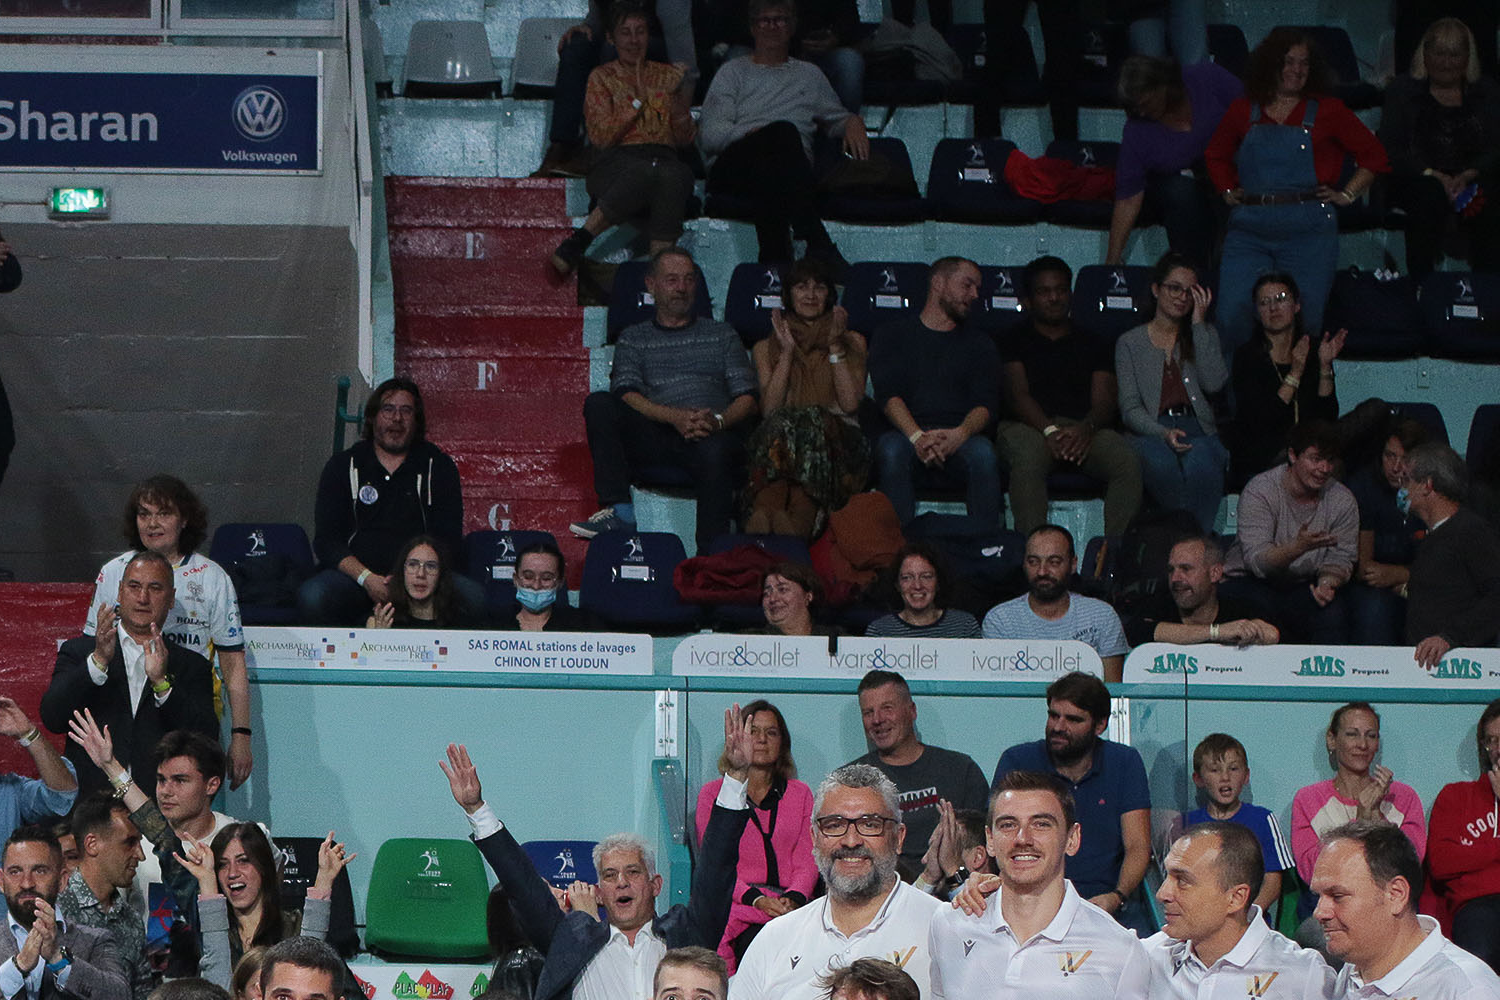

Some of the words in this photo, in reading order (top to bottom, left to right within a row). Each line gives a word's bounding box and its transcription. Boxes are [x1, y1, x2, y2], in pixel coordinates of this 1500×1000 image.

[221, 149, 298, 164] Volkswagen
[465, 232, 485, 260] E
[476, 361, 498, 390] F
[488, 503, 512, 532] G
[468, 639, 489, 651] SAS
[492, 639, 533, 651] ROMAL
[536, 641, 578, 652] stations
[580, 641, 594, 653] de
[596, 641, 636, 656] lavages
[690, 641, 801, 668] ivars&ballet
[972, 645, 1083, 672] ivars&ballet
[494, 656, 541, 668] CHINON
[544, 657, 558, 668] ET
[561, 658, 609, 669] LOUDUN
[1152, 653, 1199, 675] AMS
[1299, 655, 1346, 677] AMS
[1436, 658, 1482, 680] AMS
